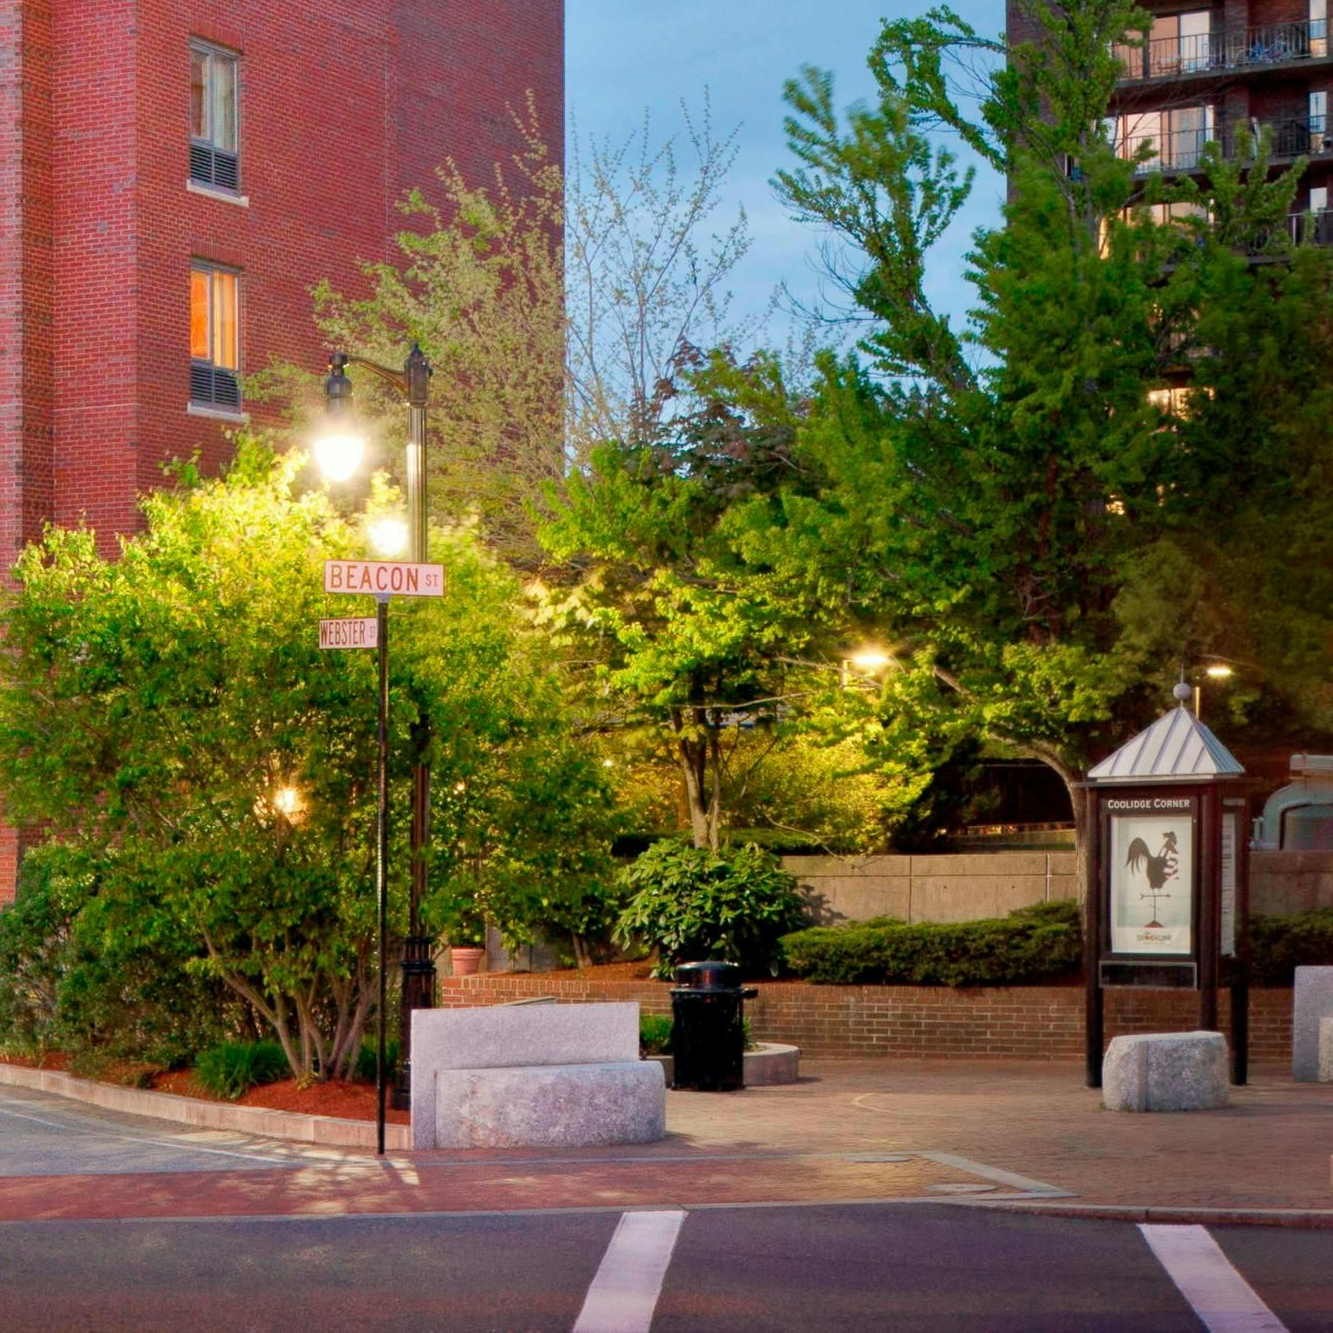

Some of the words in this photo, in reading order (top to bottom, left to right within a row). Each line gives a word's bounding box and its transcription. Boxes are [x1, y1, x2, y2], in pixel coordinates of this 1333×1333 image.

[330, 565, 419, 592] BEACON
[425, 573, 439, 587] ST
[319, 620, 366, 646] WEBSTER
[1108, 799, 1151, 809] COOLIDGE
[1154, 798, 1190, 808] CORNER
